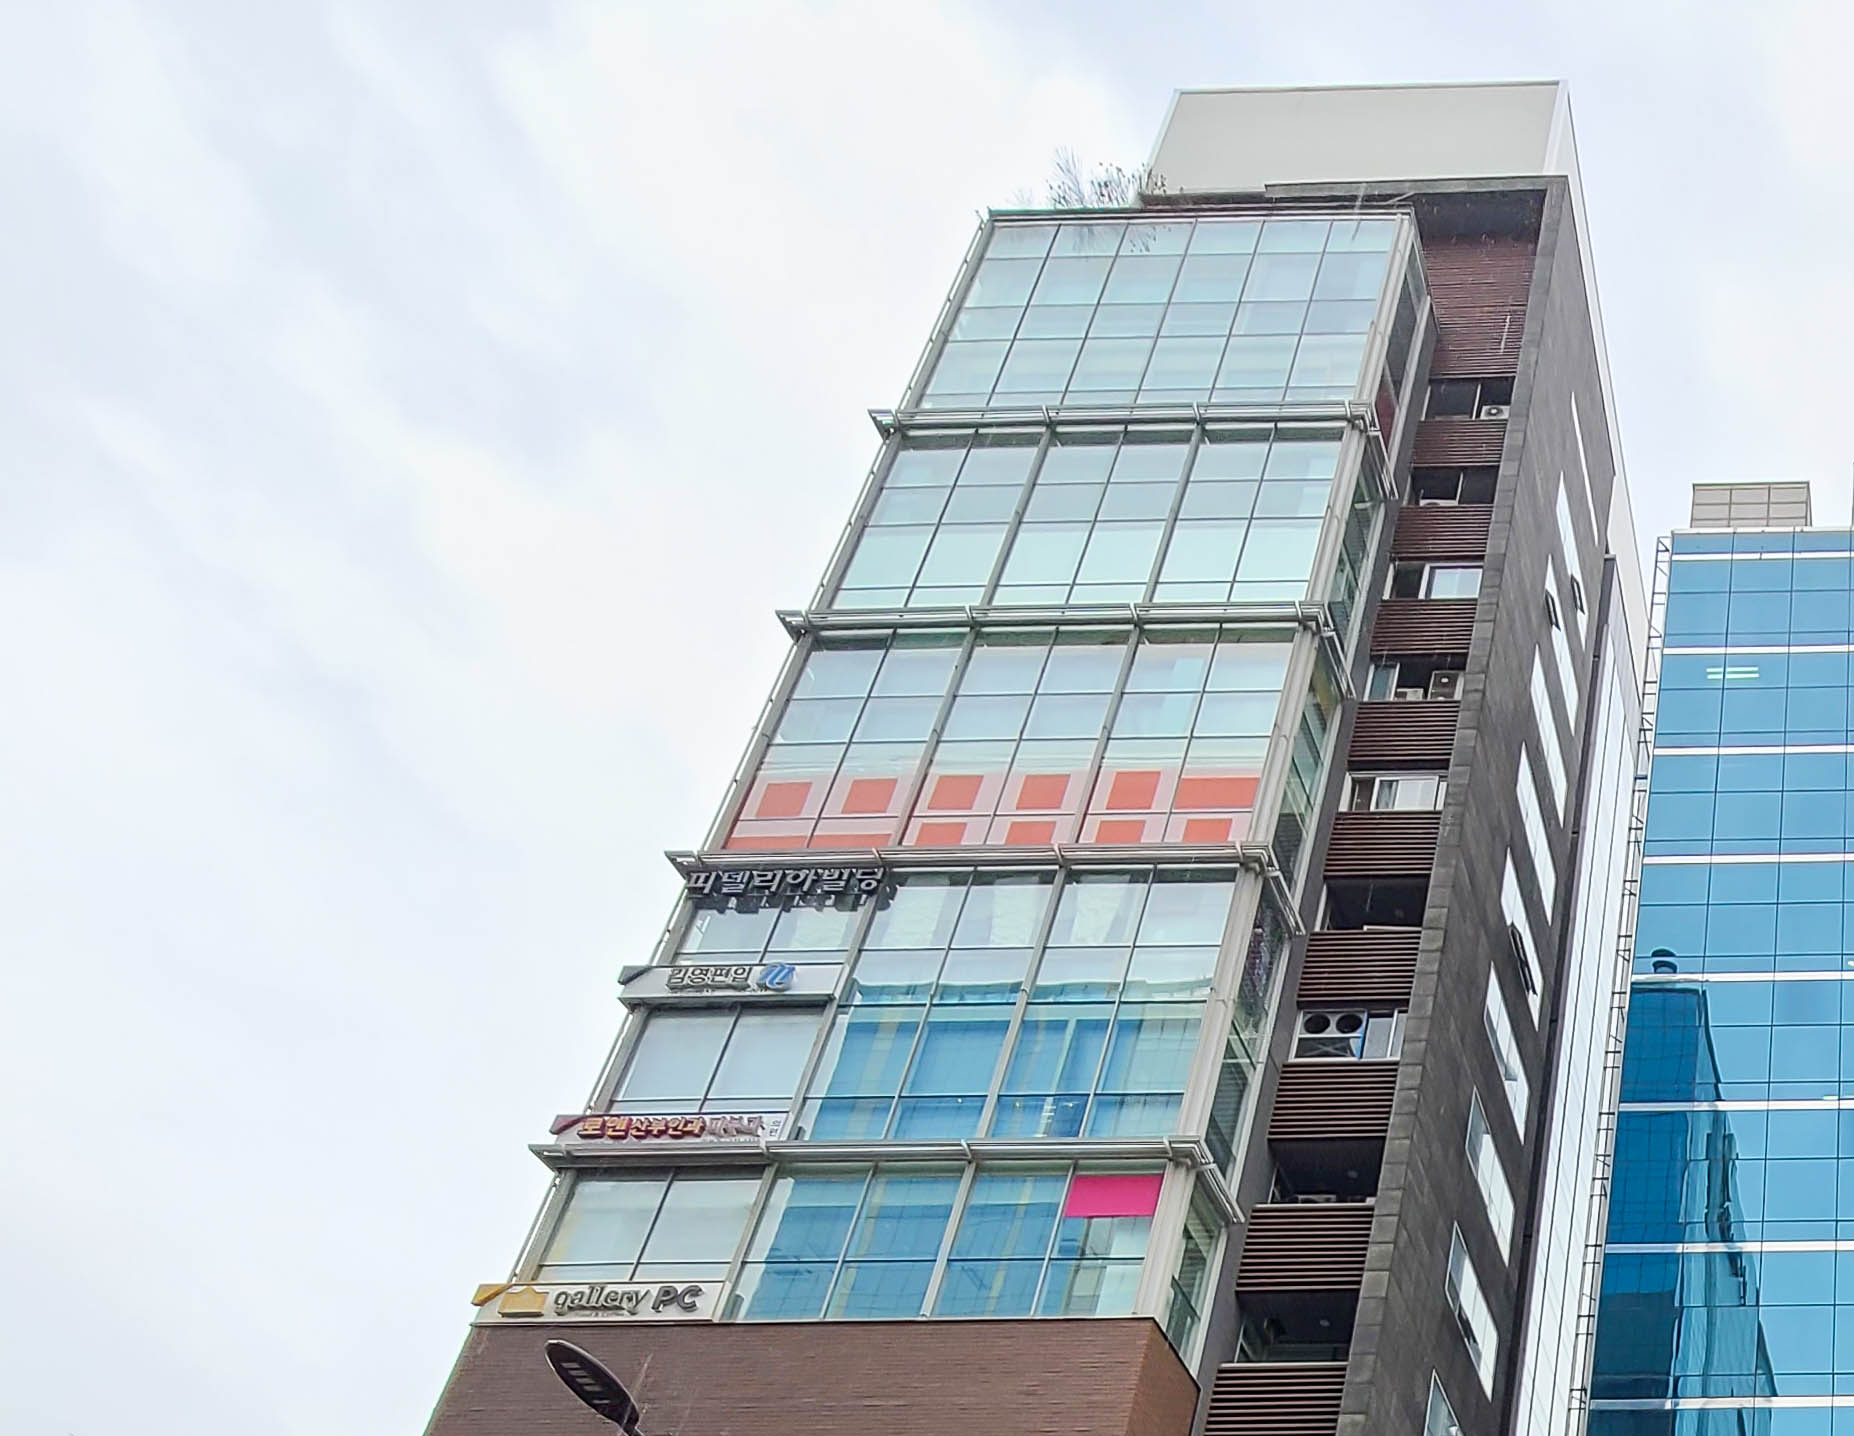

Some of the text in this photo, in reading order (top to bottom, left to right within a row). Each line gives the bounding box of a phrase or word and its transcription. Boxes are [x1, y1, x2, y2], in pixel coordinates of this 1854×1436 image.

[667, 966, 751, 988] 김영편입
[553, 1285, 703, 1315] gallery PC
